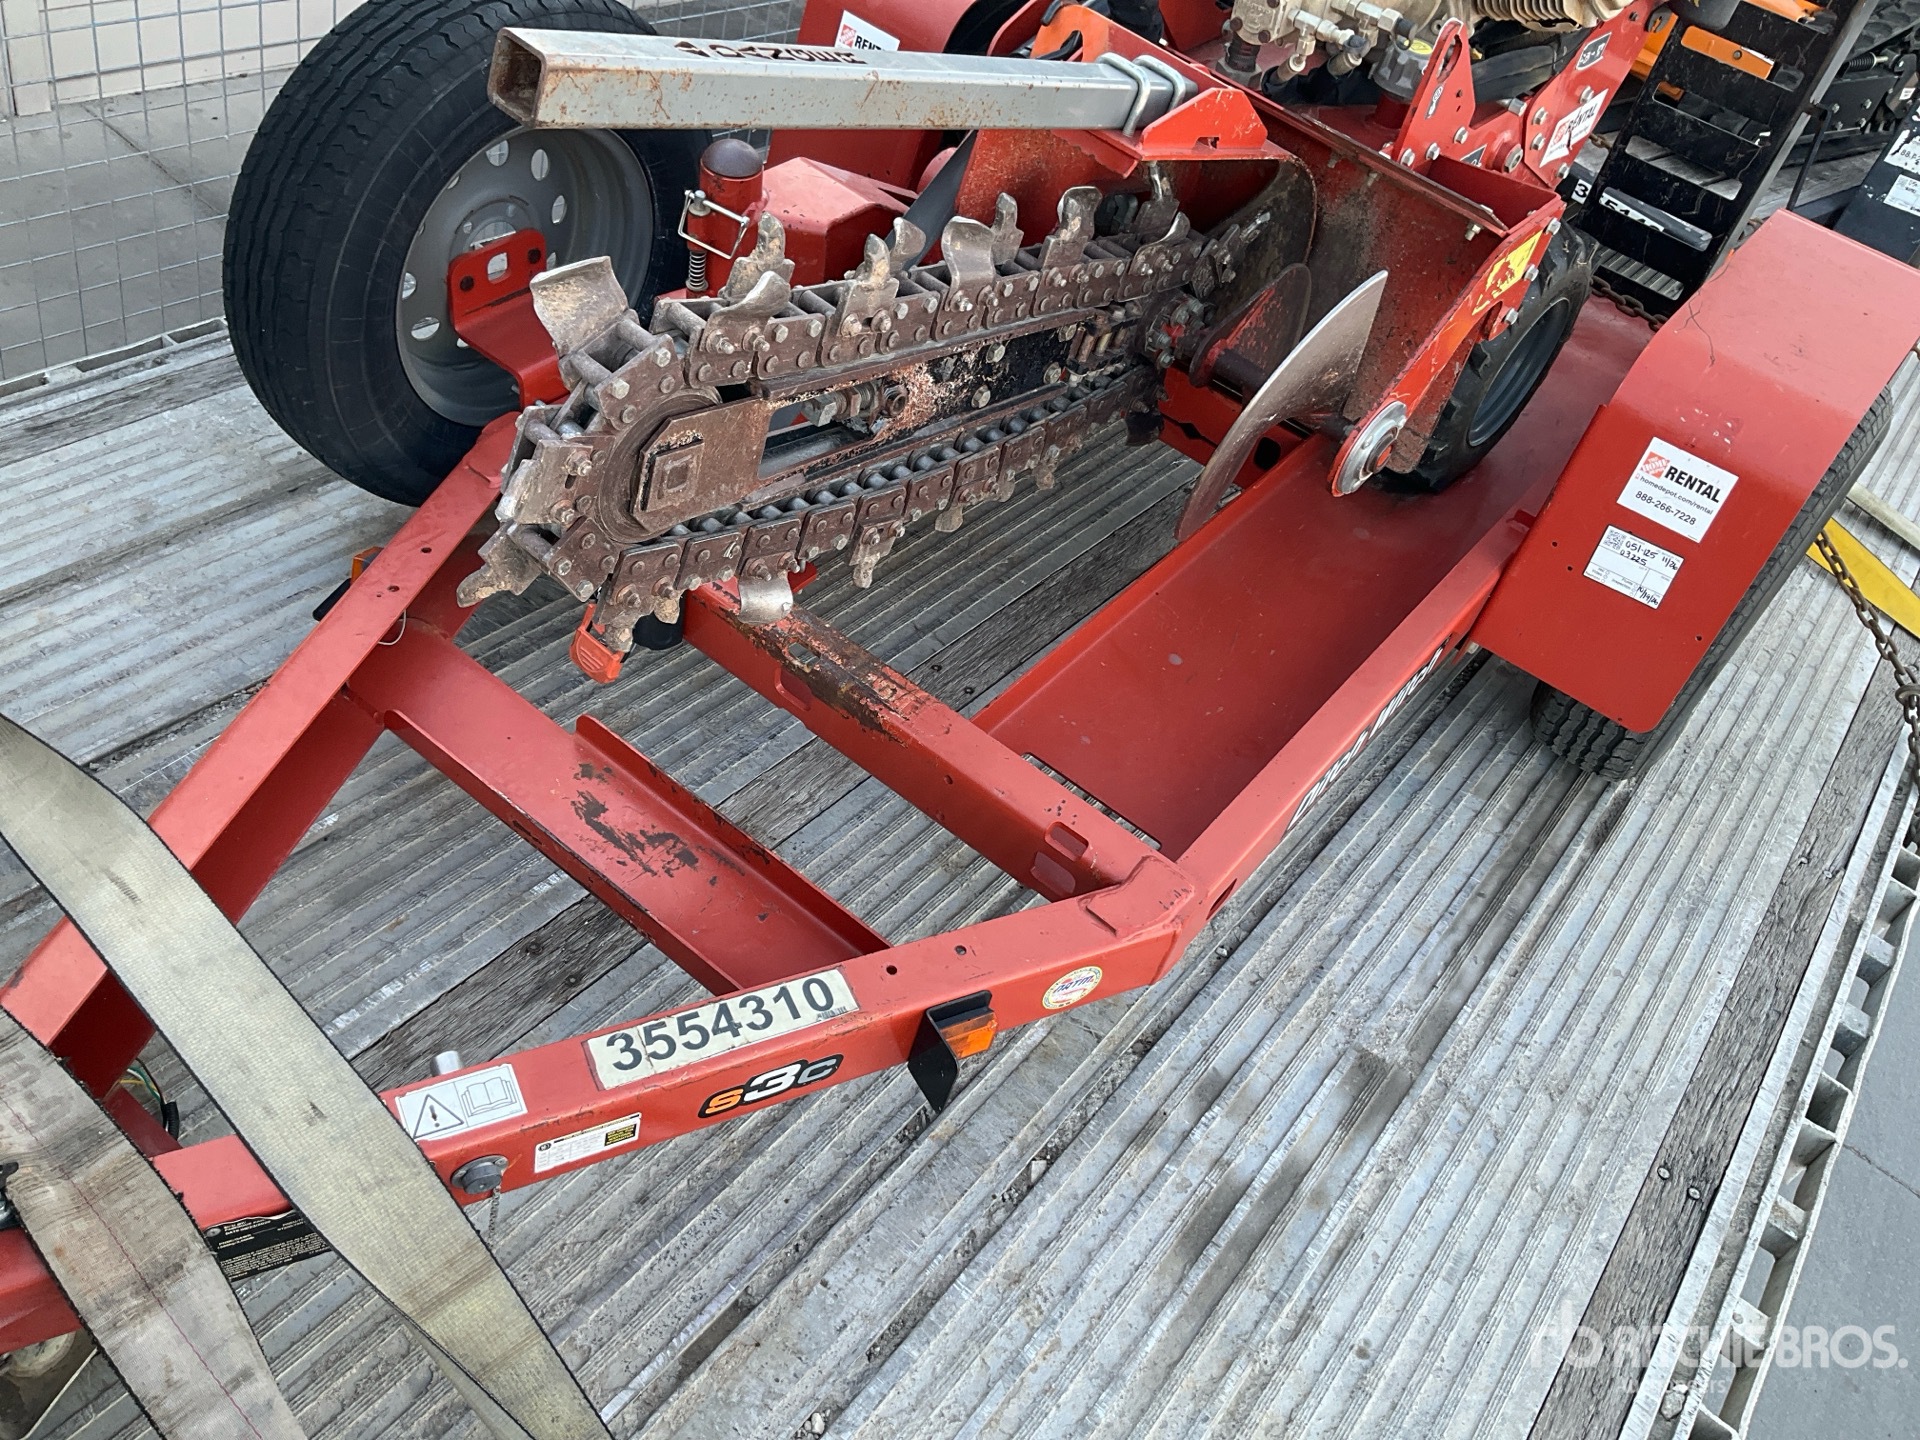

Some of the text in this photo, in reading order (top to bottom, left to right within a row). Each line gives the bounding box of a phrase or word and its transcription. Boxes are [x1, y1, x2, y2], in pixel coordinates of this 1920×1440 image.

[1640, 476, 1714, 515] homedepot.com/rental
[1664, 466, 1721, 503] RENTAL
[1635, 490, 1697, 526] 888-266-7228
[606, 978, 834, 1071] 3554310
